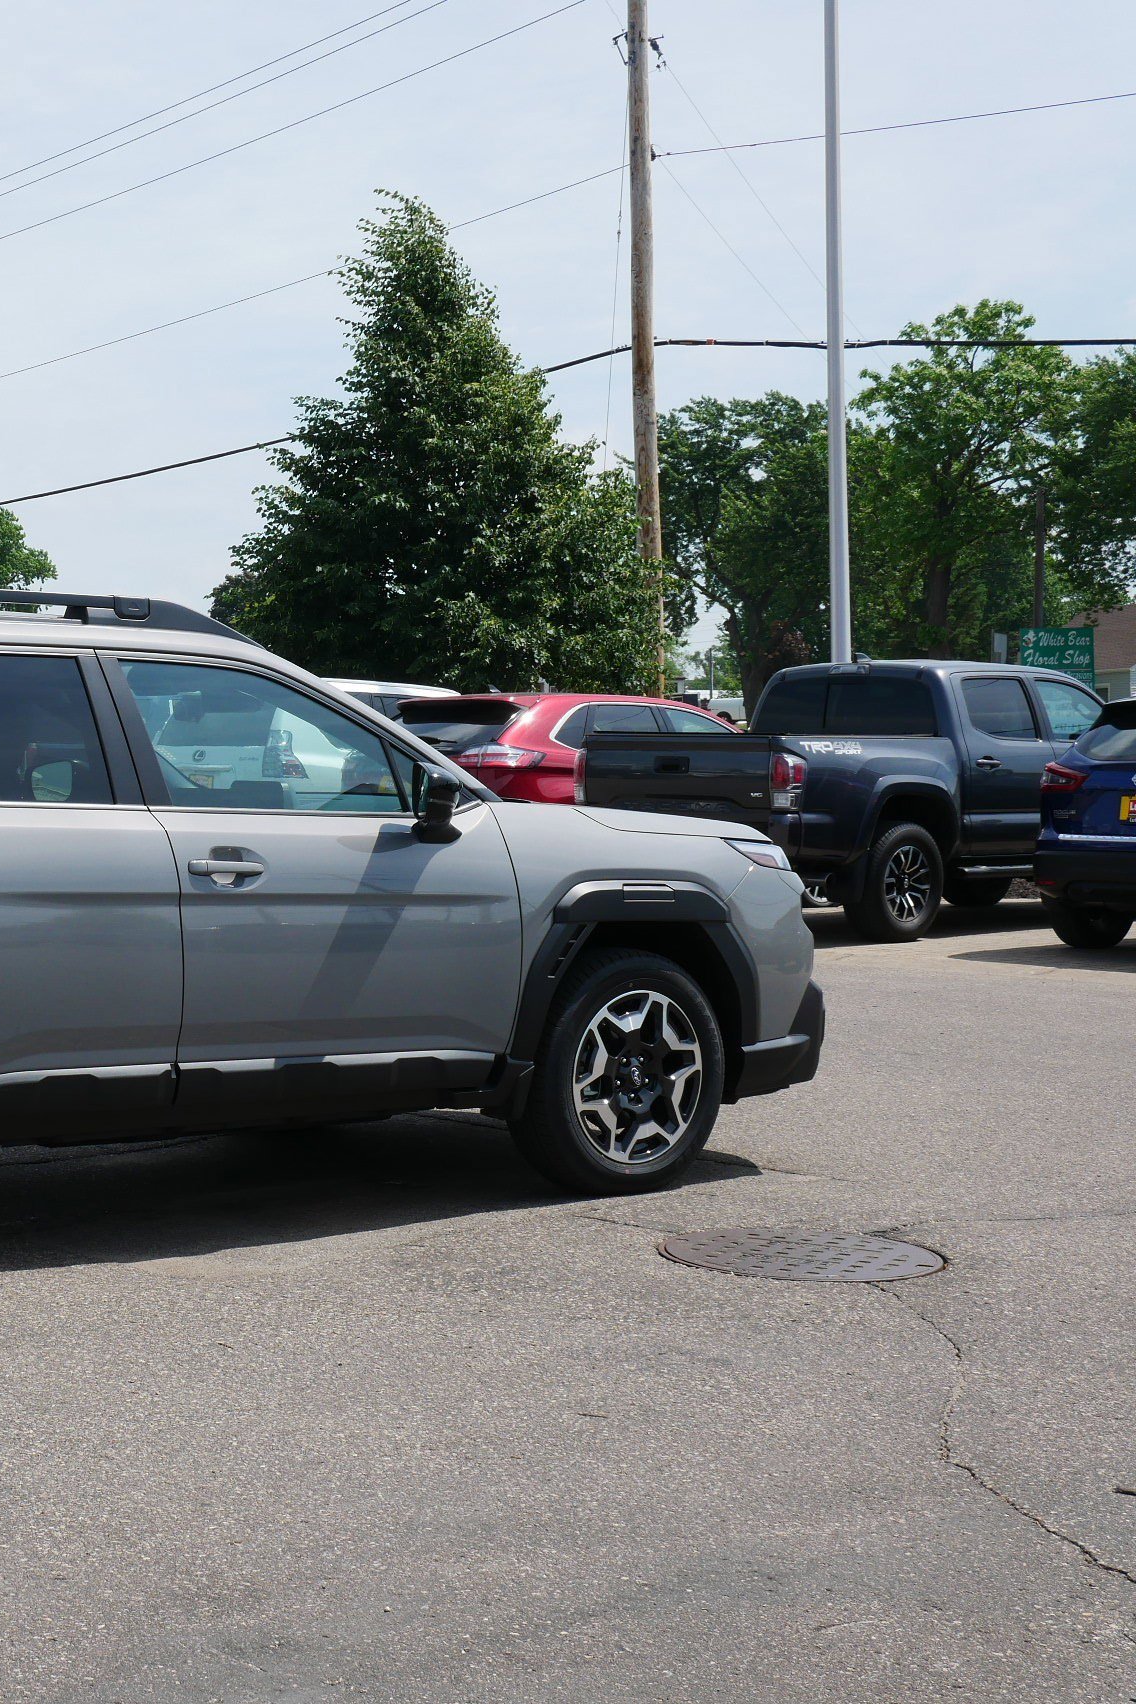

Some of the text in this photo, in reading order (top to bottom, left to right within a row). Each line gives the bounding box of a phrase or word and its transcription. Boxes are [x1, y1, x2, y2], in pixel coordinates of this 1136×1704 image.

[1038, 631, 1091, 647] White Bear
[1024, 649, 1091, 667] Floral Shop
[799, 741, 834, 754] TRD
